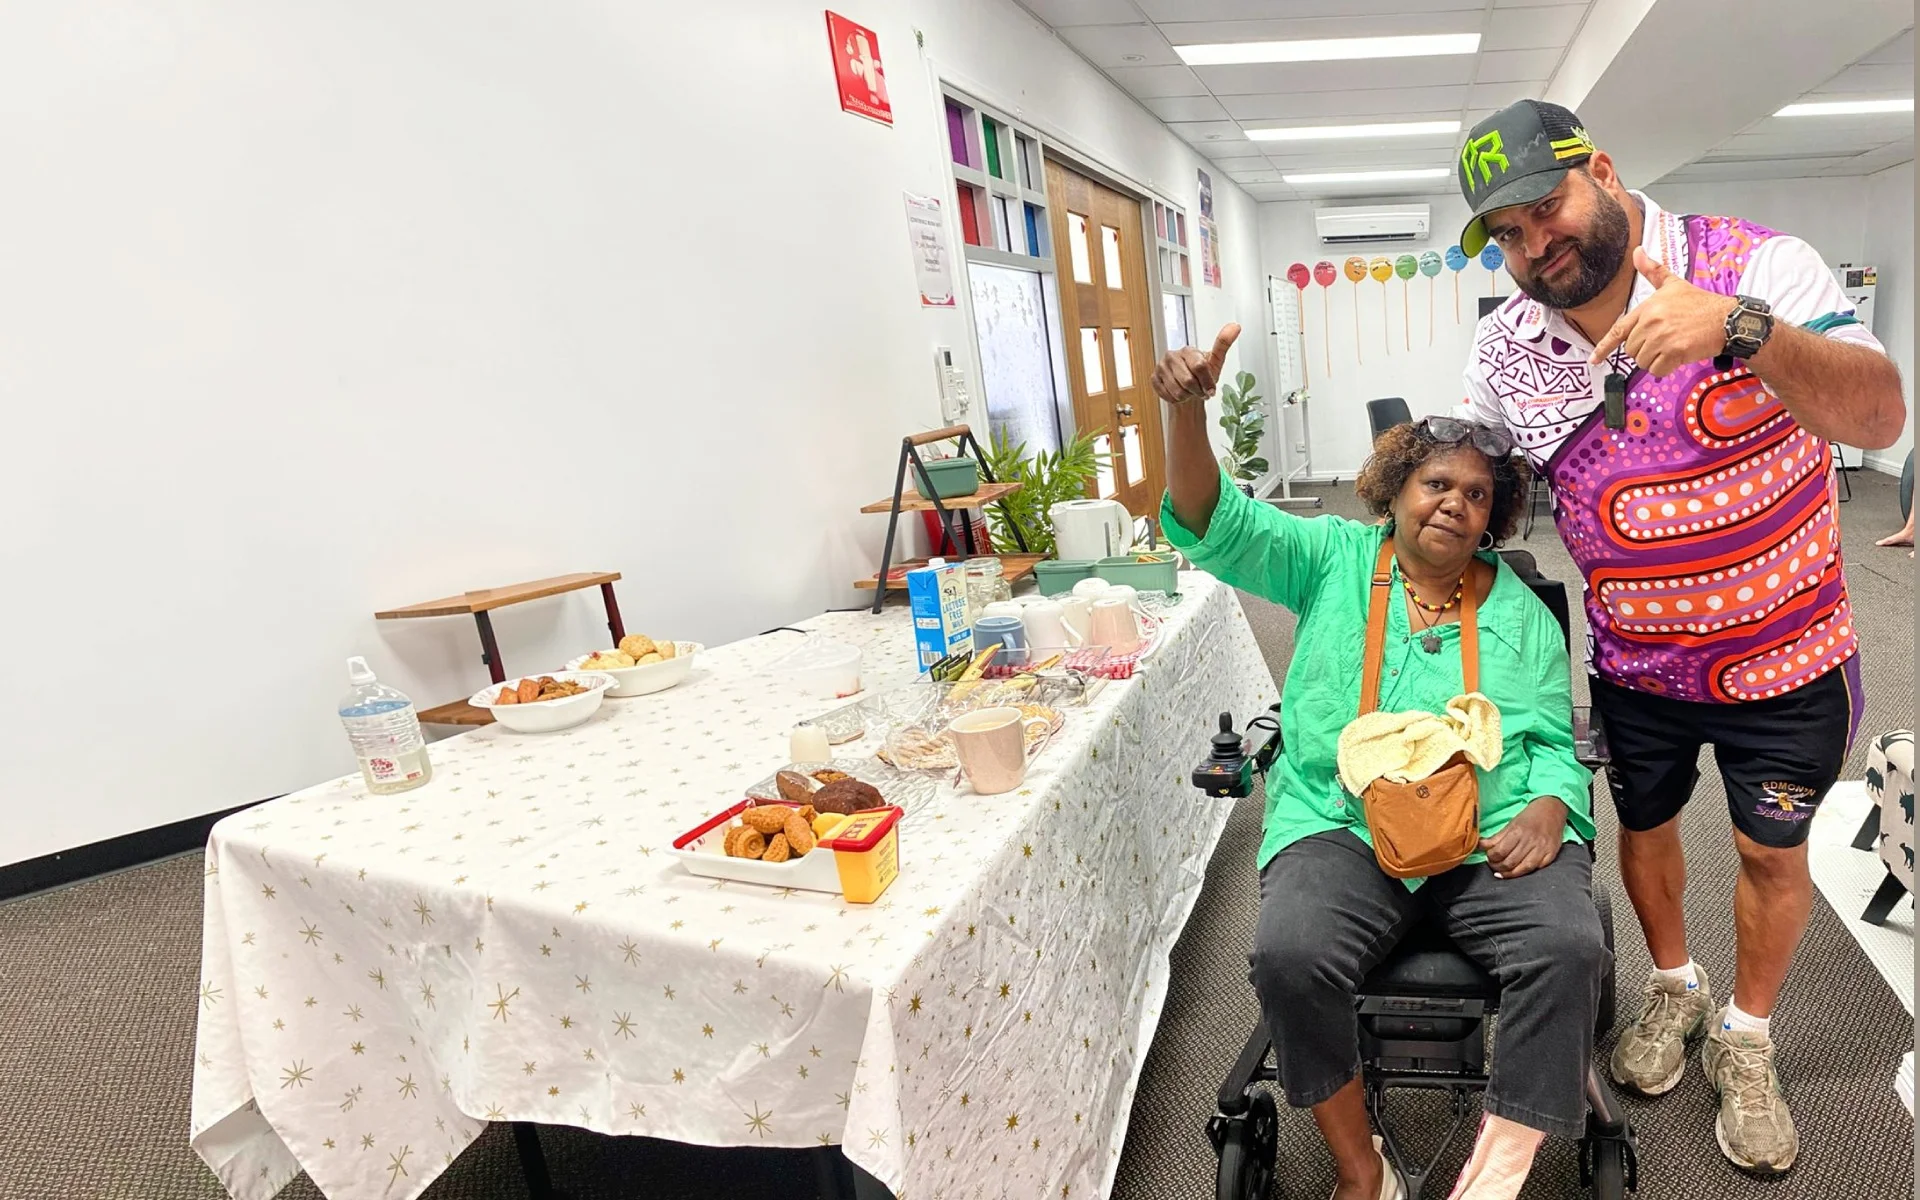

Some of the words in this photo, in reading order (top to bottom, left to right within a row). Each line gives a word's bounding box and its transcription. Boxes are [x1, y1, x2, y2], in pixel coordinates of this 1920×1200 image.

[1669, 231, 1680, 275] COMMUNITY
[942, 597, 966, 613] LACTOSE
[949, 608, 963, 621] FREE
